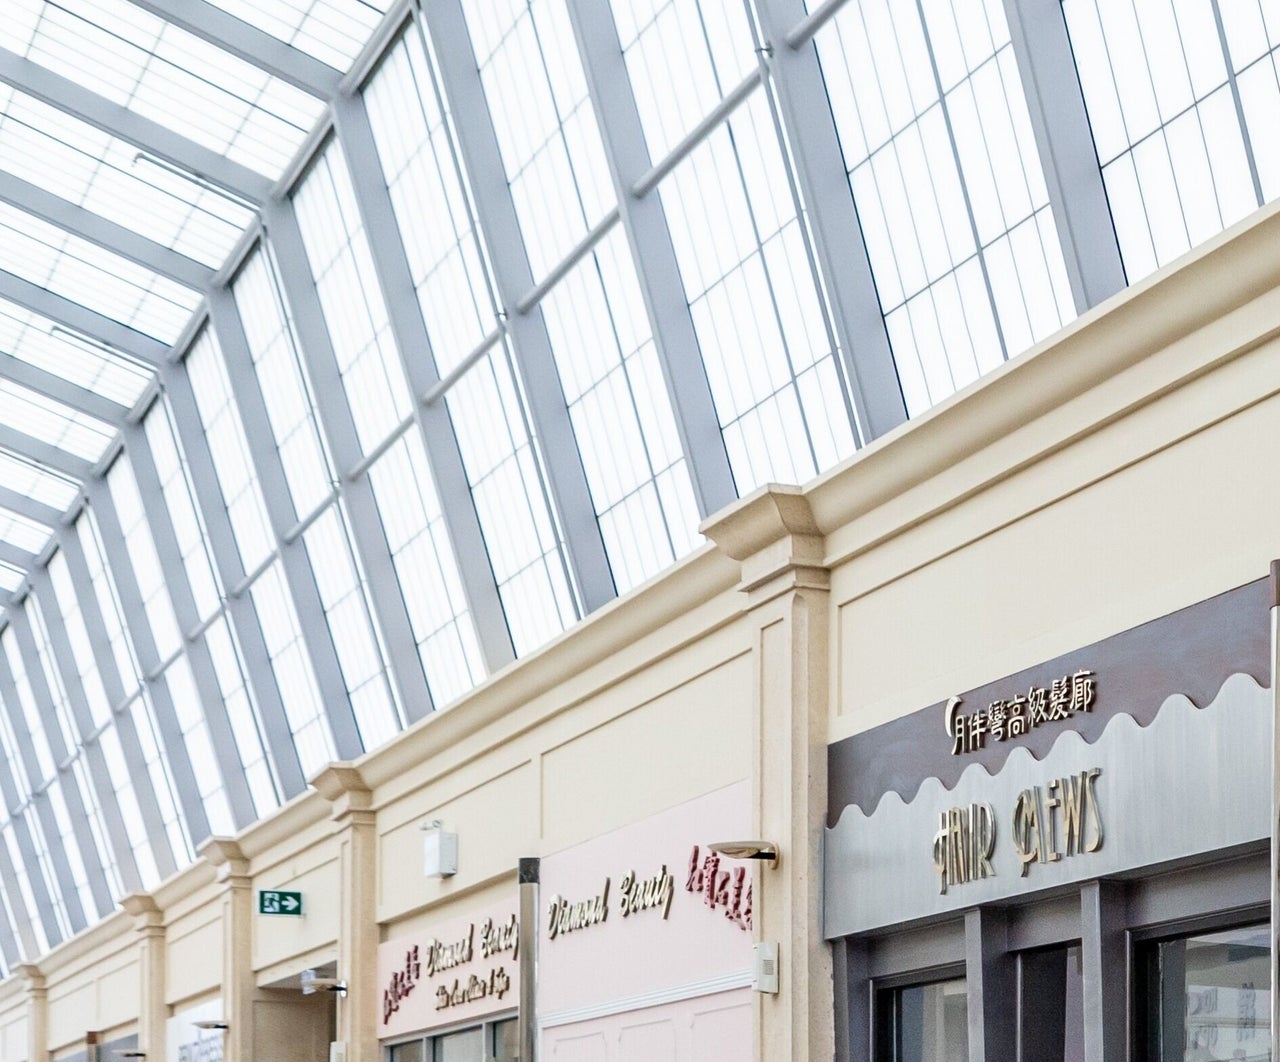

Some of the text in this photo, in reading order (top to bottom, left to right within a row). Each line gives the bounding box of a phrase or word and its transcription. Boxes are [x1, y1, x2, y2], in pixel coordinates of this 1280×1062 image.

[933, 801, 997, 895] HAIR
[549, 865, 674, 940] Diamond Beauty
